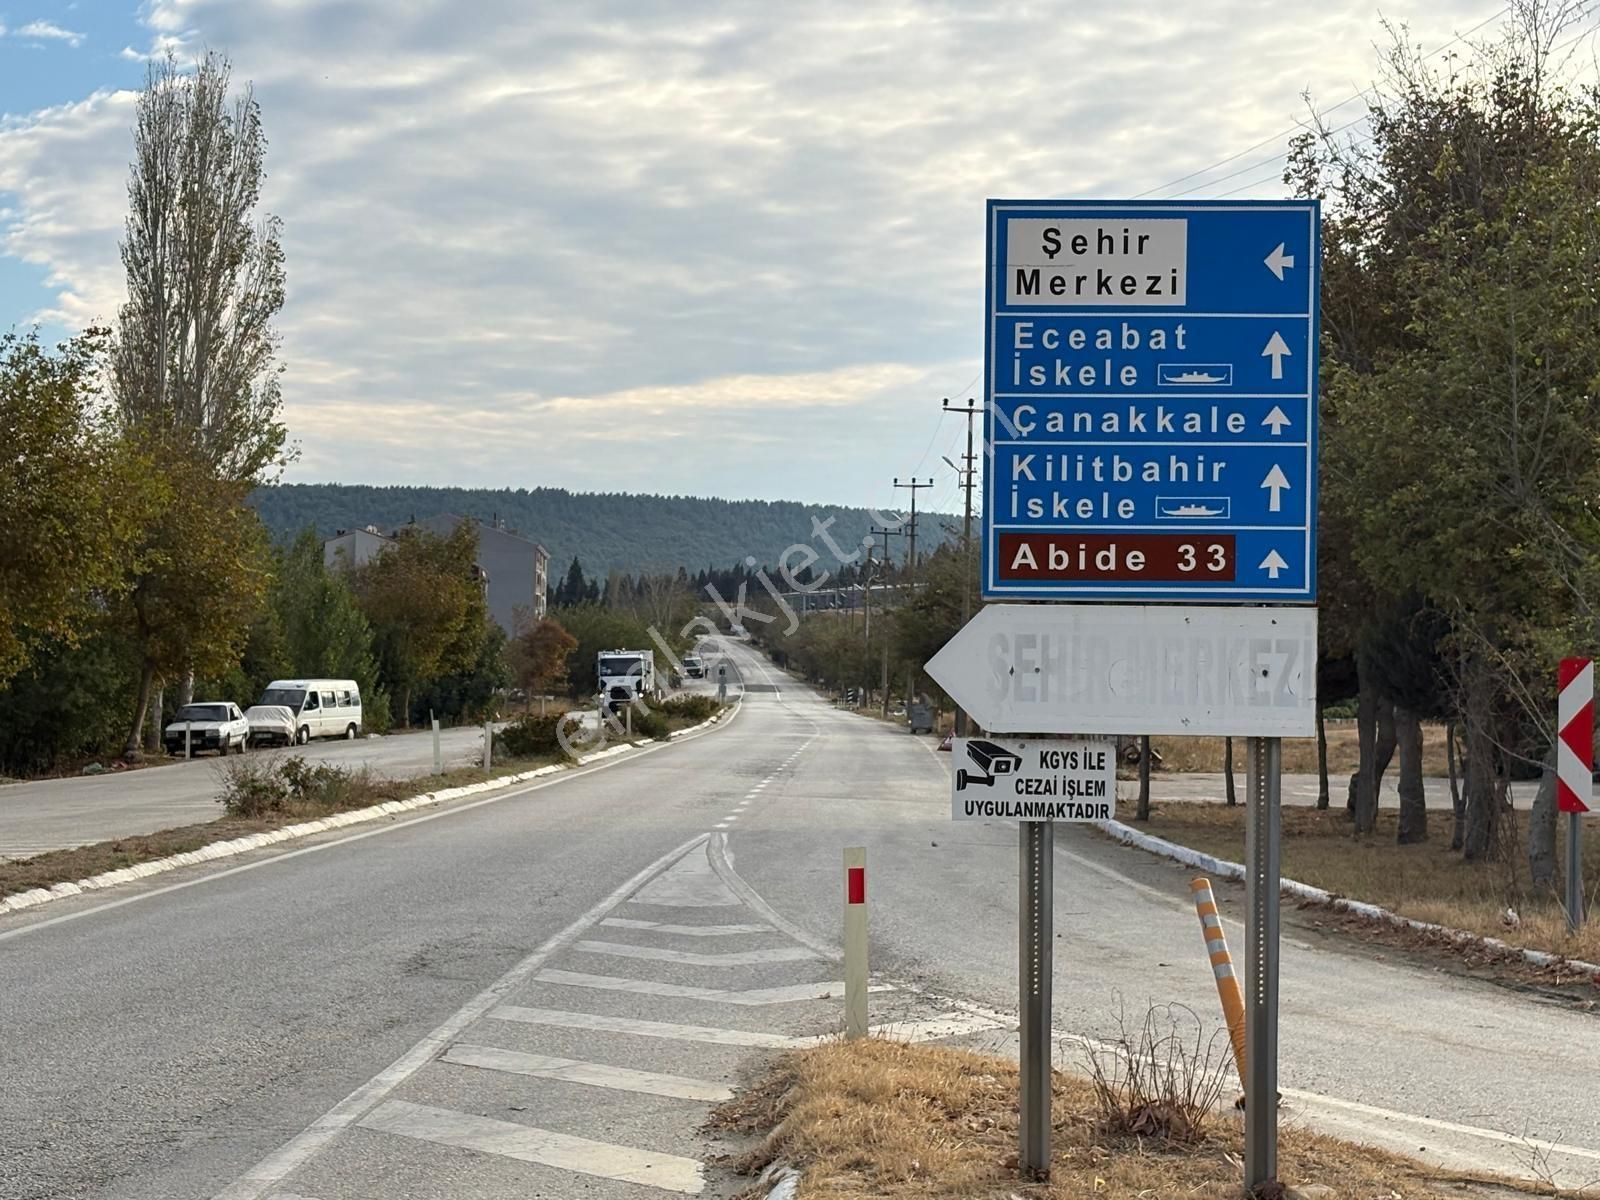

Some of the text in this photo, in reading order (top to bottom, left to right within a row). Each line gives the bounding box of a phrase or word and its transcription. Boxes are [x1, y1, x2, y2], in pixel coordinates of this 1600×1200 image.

[1042, 227, 1150, 259] Şehir
[1015, 269, 1178, 296] Merkezi
[1014, 322, 1187, 350] Eceabat
[1013, 352, 1138, 386] İskele
[1012, 405, 1247, 437] Çanakkale
[1011, 454, 1226, 482] Kilitbahir
[1011, 485, 1136, 518] İskele
[1011, 543, 1227, 571] Abide 33
[1040, 747, 1106, 770] KGYS İLE
[1015, 775, 1106, 800] CEZAİ İŞLEM
[965, 800, 1110, 819] UYGULANMAKTADIR
